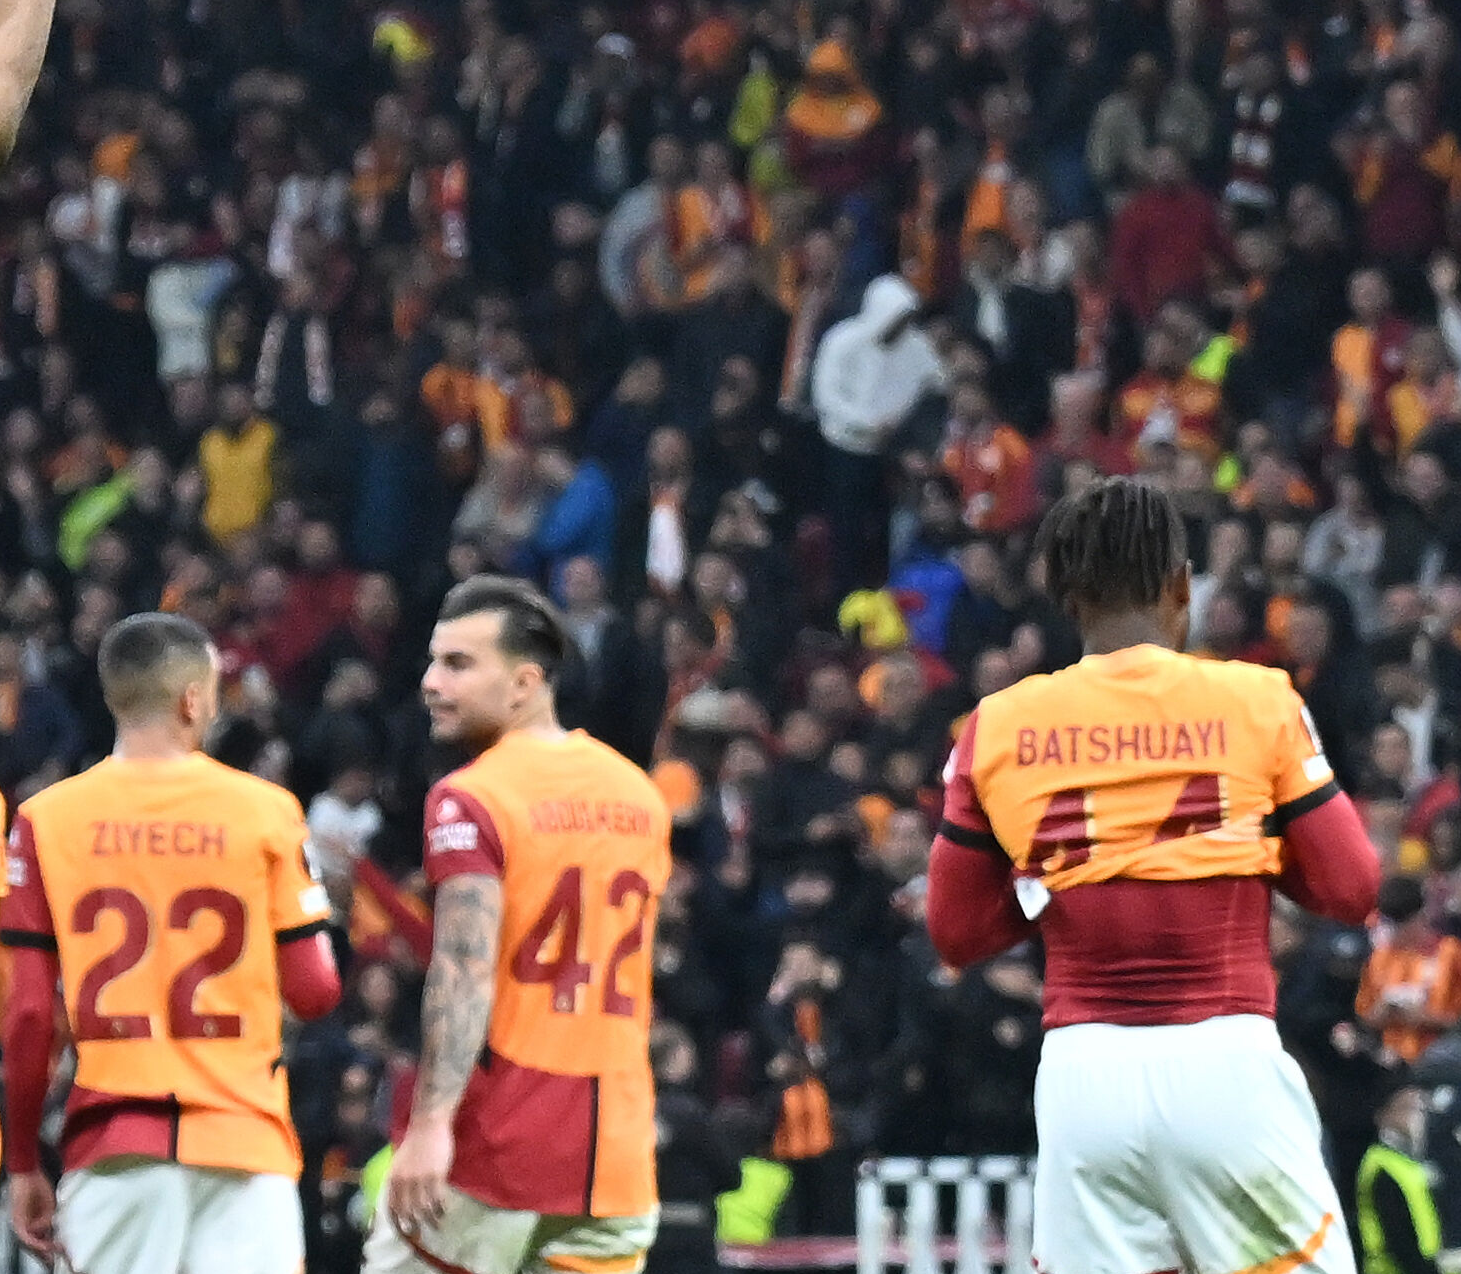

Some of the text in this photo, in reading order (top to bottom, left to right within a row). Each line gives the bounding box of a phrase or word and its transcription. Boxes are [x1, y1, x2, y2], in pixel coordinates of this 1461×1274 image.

[1017, 718, 1226, 767] BATSHUAYI
[92, 821, 225, 858] ZIYECH
[72, 887, 248, 1041] 22
[510, 866, 650, 1017] 42
